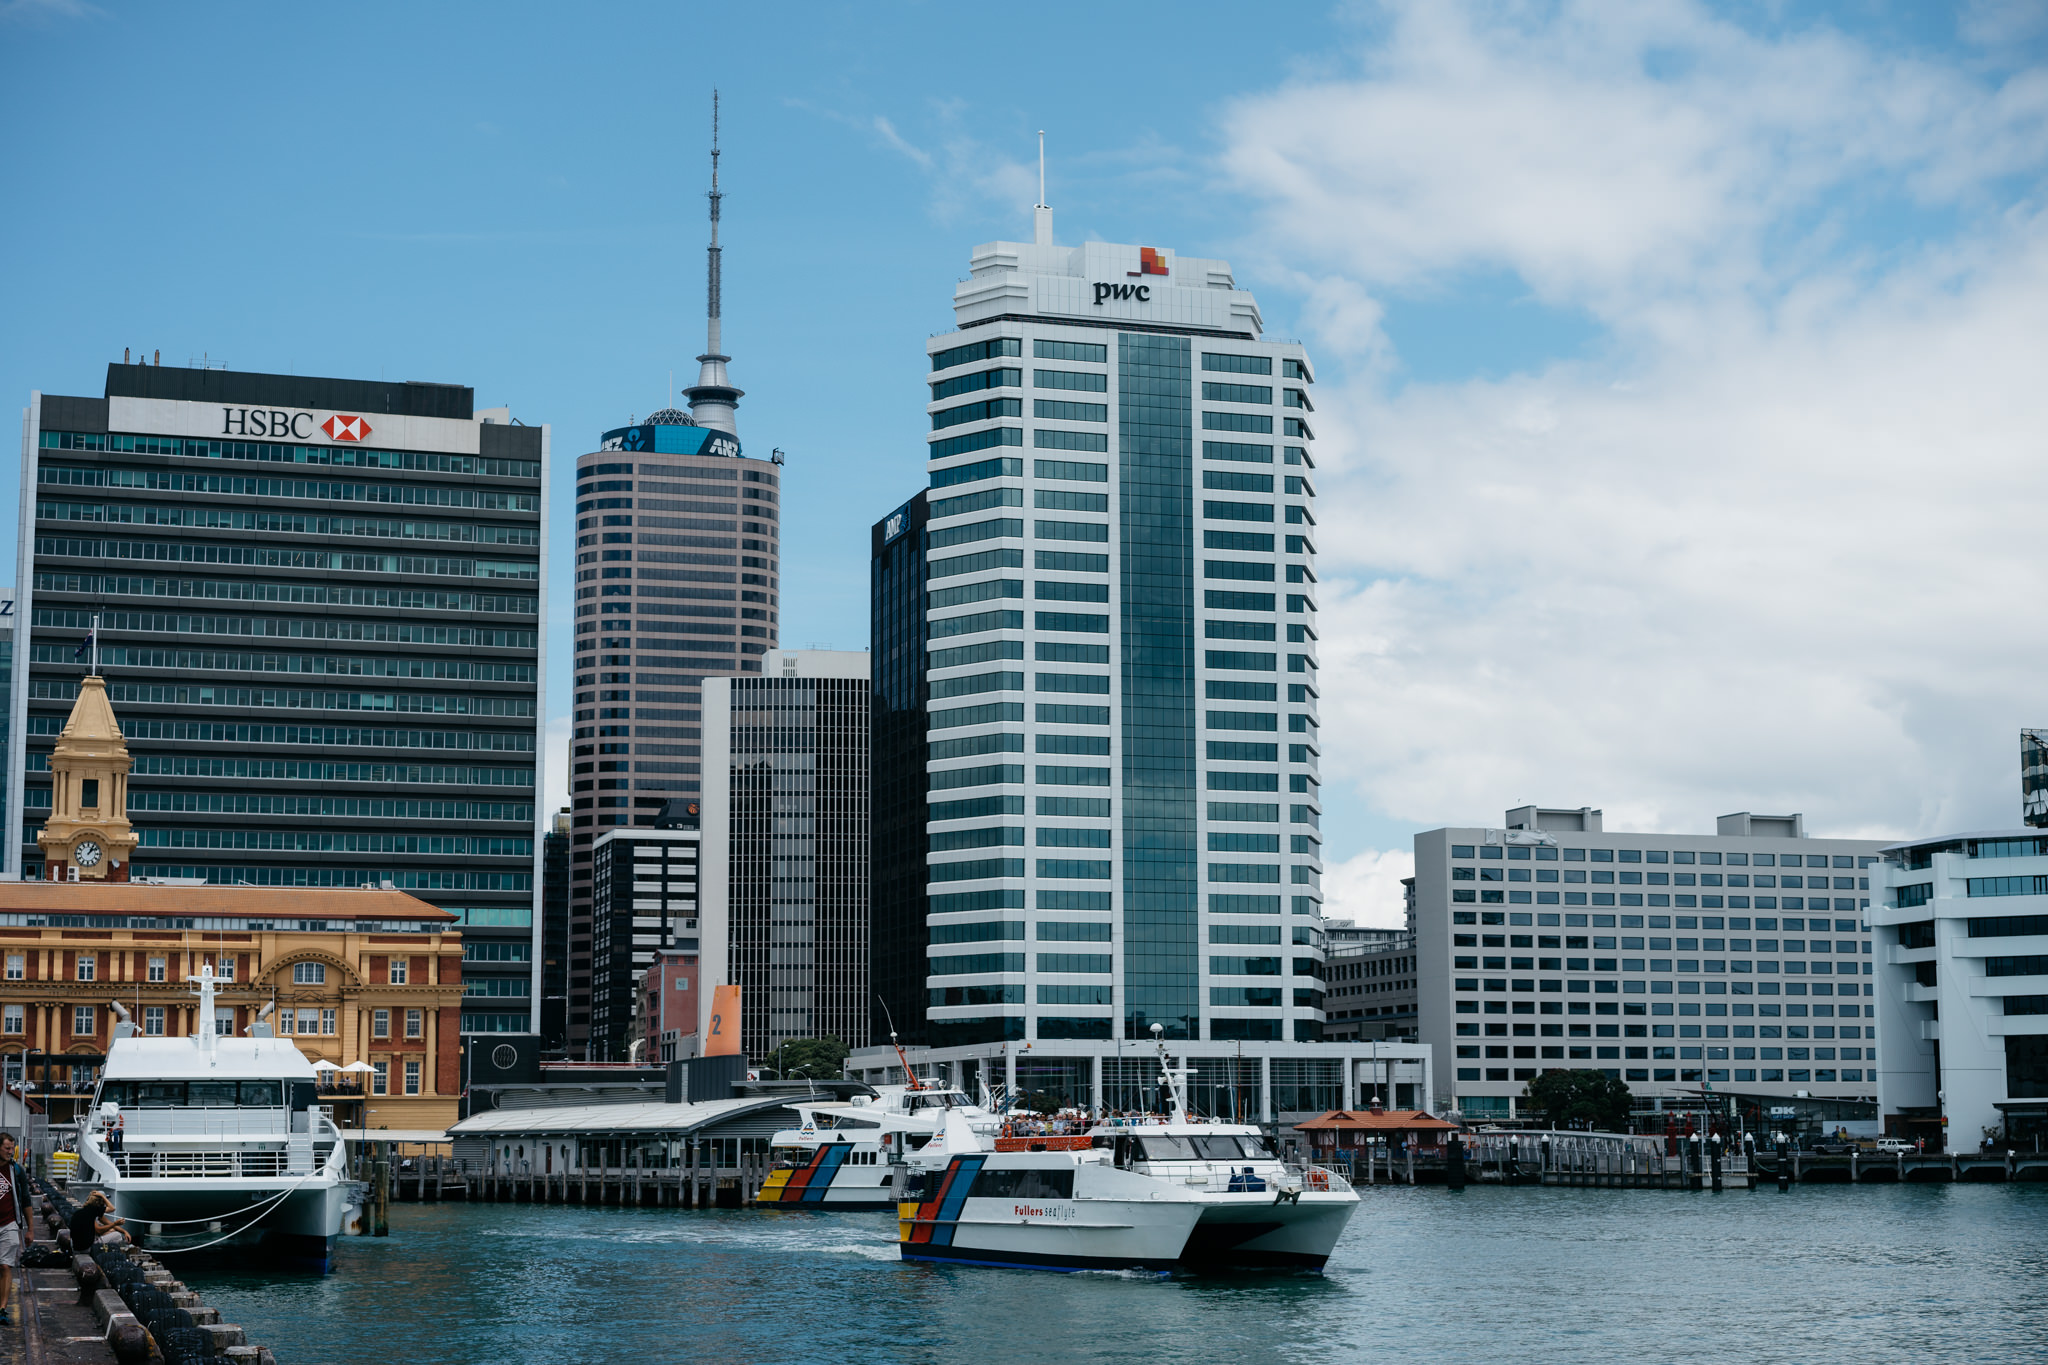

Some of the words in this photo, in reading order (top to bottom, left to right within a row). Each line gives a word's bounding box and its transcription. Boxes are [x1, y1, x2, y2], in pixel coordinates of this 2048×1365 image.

[1093, 282, 1150, 305] pwc
[222, 408, 313, 439] HSBC
[709, 438, 738, 457] ANZ
[885, 514, 901, 540] AMP
[712, 1014, 722, 1035] 2
[1771, 1106, 1796, 1115] OK
[1015, 1205, 1043, 1216] Fullers
